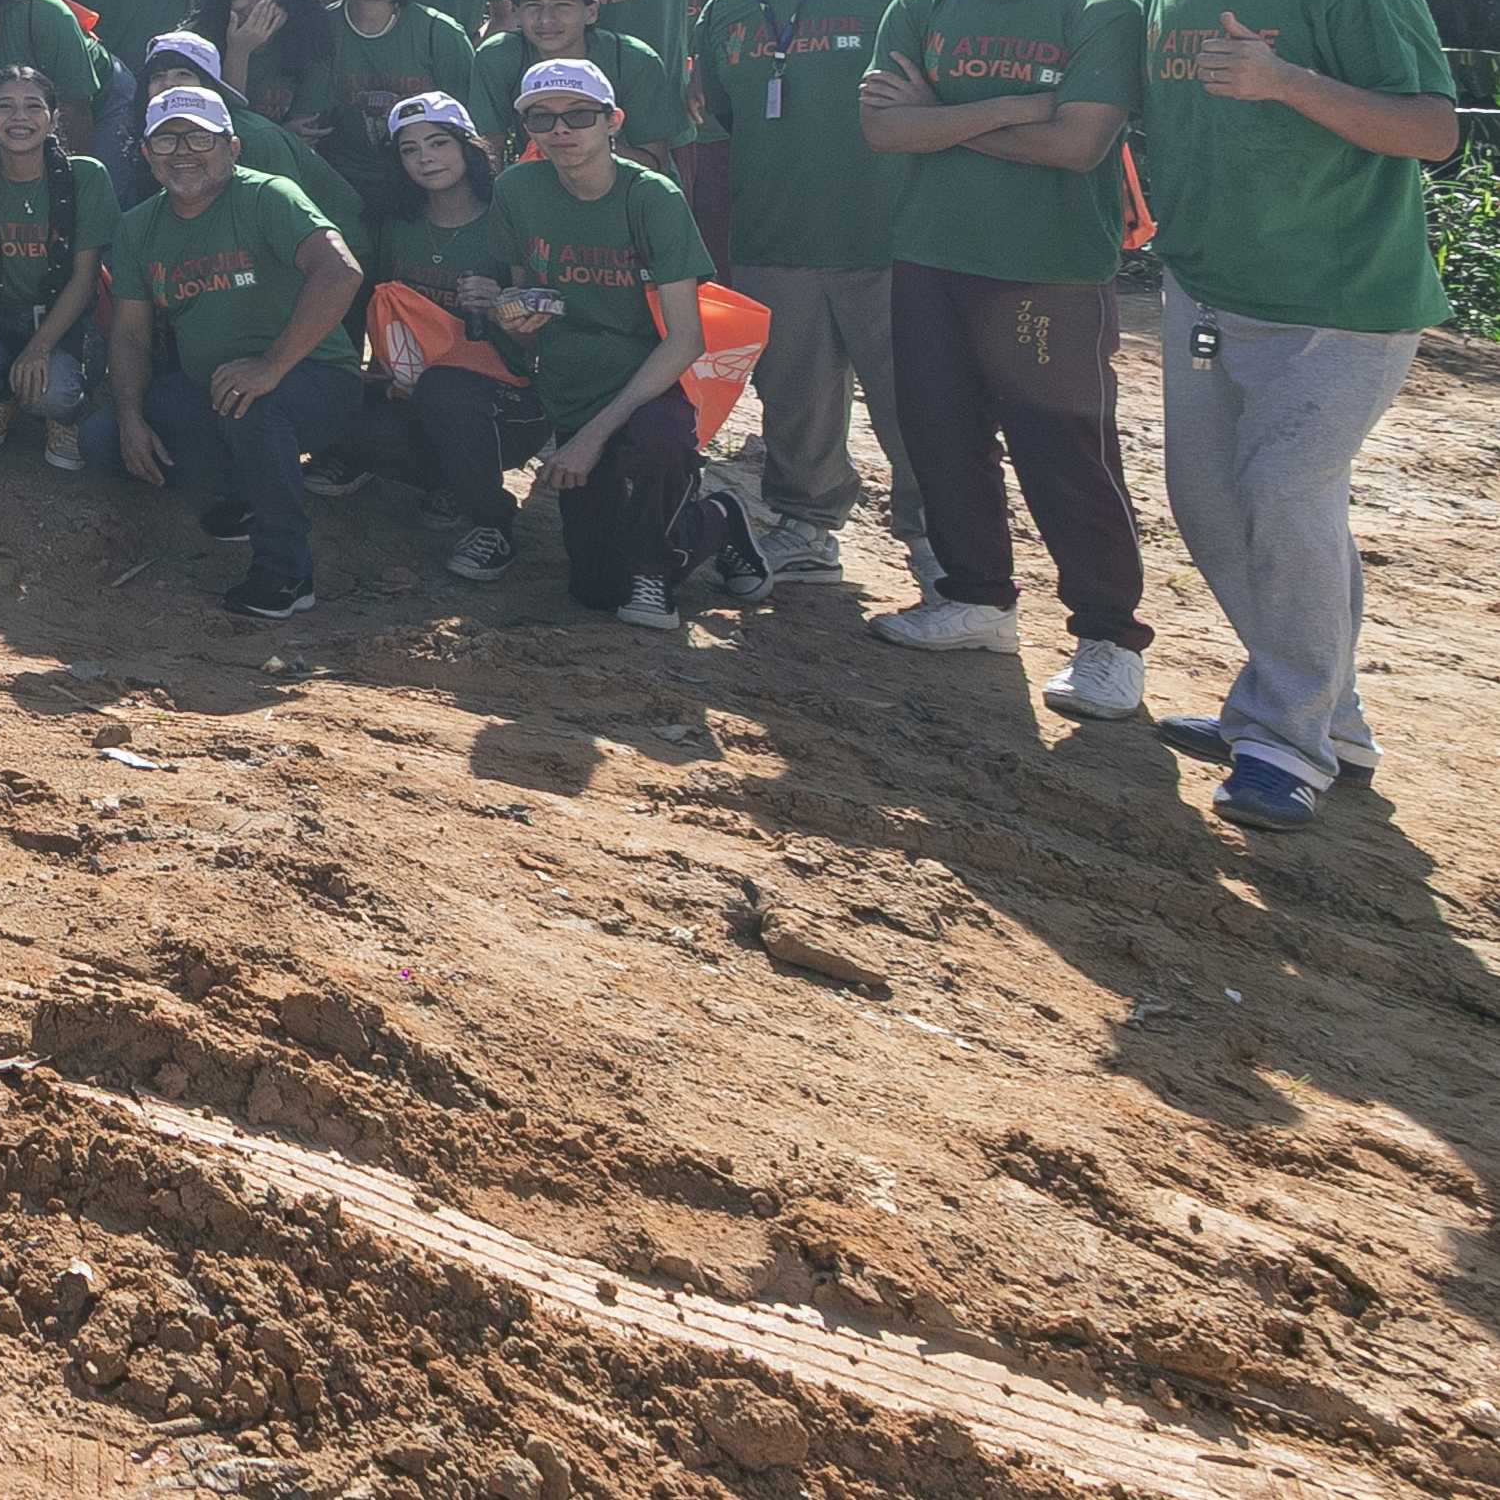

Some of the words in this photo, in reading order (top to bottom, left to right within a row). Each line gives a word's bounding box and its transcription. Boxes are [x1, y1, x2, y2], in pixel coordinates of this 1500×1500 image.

[836, 34, 861, 49] BR
[543, 79, 584, 88] ATITUDE
[234, 271, 256, 287] BR
[557, 265, 636, 288] JOVEM
